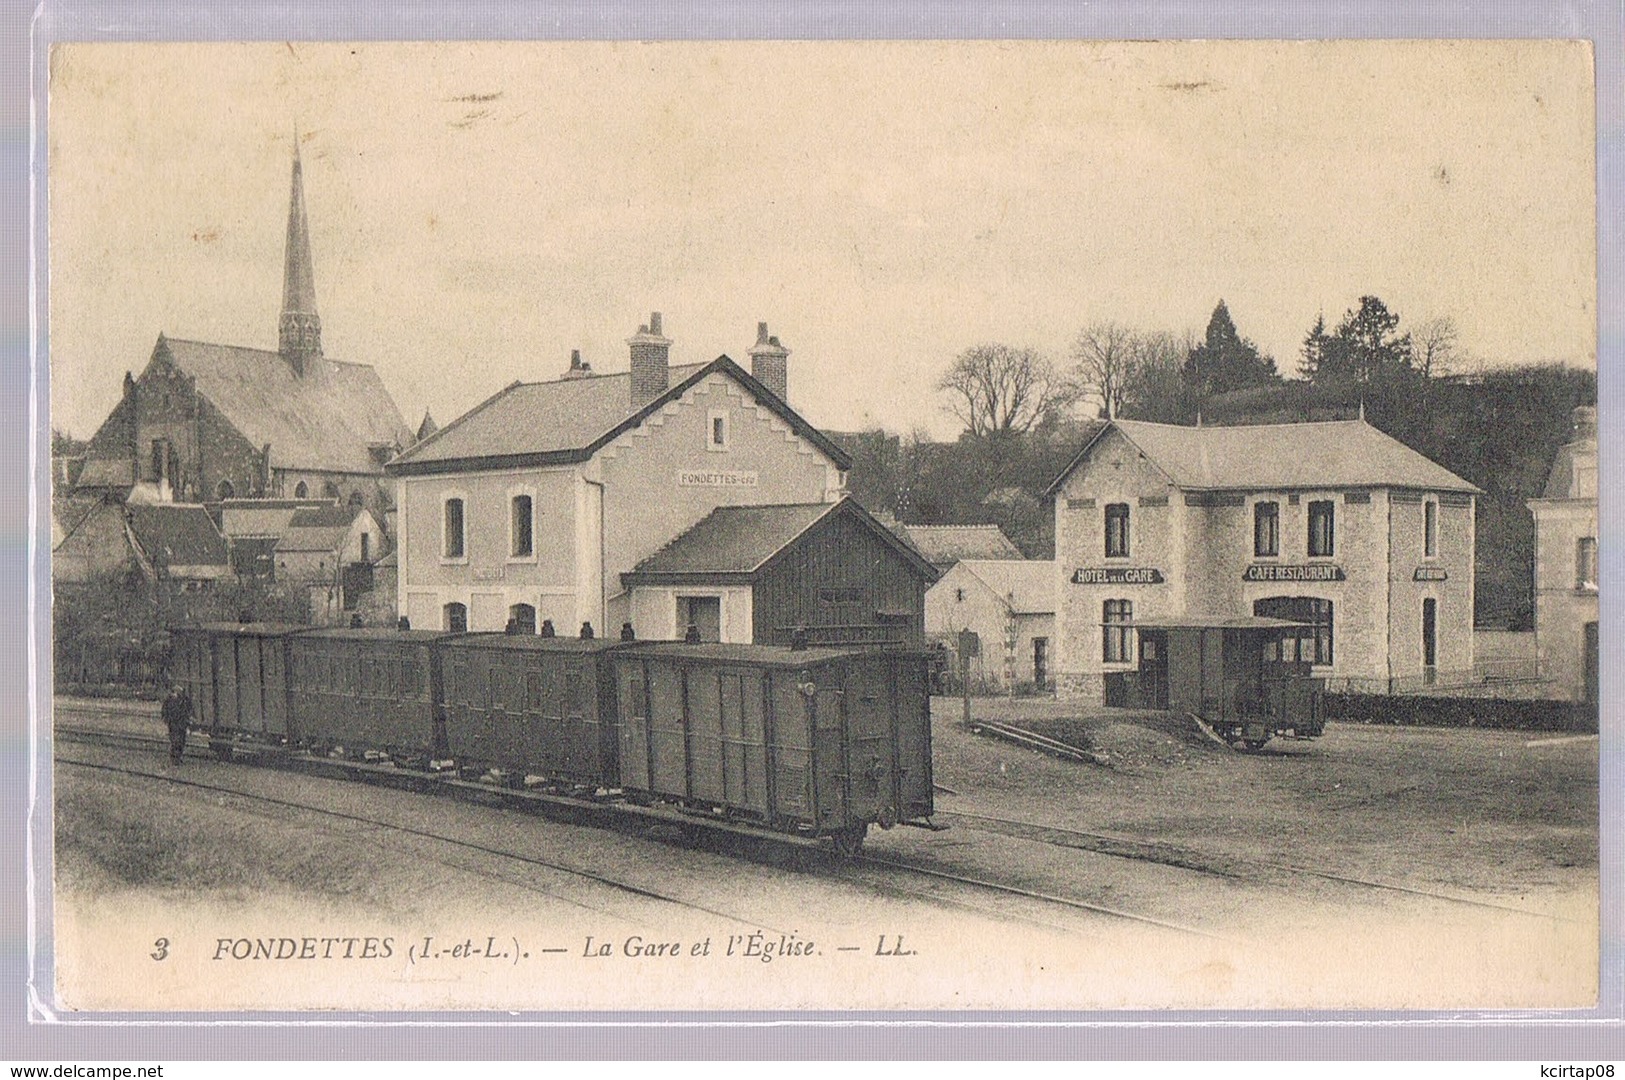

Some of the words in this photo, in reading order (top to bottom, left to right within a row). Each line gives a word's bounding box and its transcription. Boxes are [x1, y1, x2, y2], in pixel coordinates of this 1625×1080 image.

[1077, 569, 1109, 583] HOTEL
[1125, 569, 1154, 583] GARE
[1275, 566, 1339, 580] RESTAURANT
